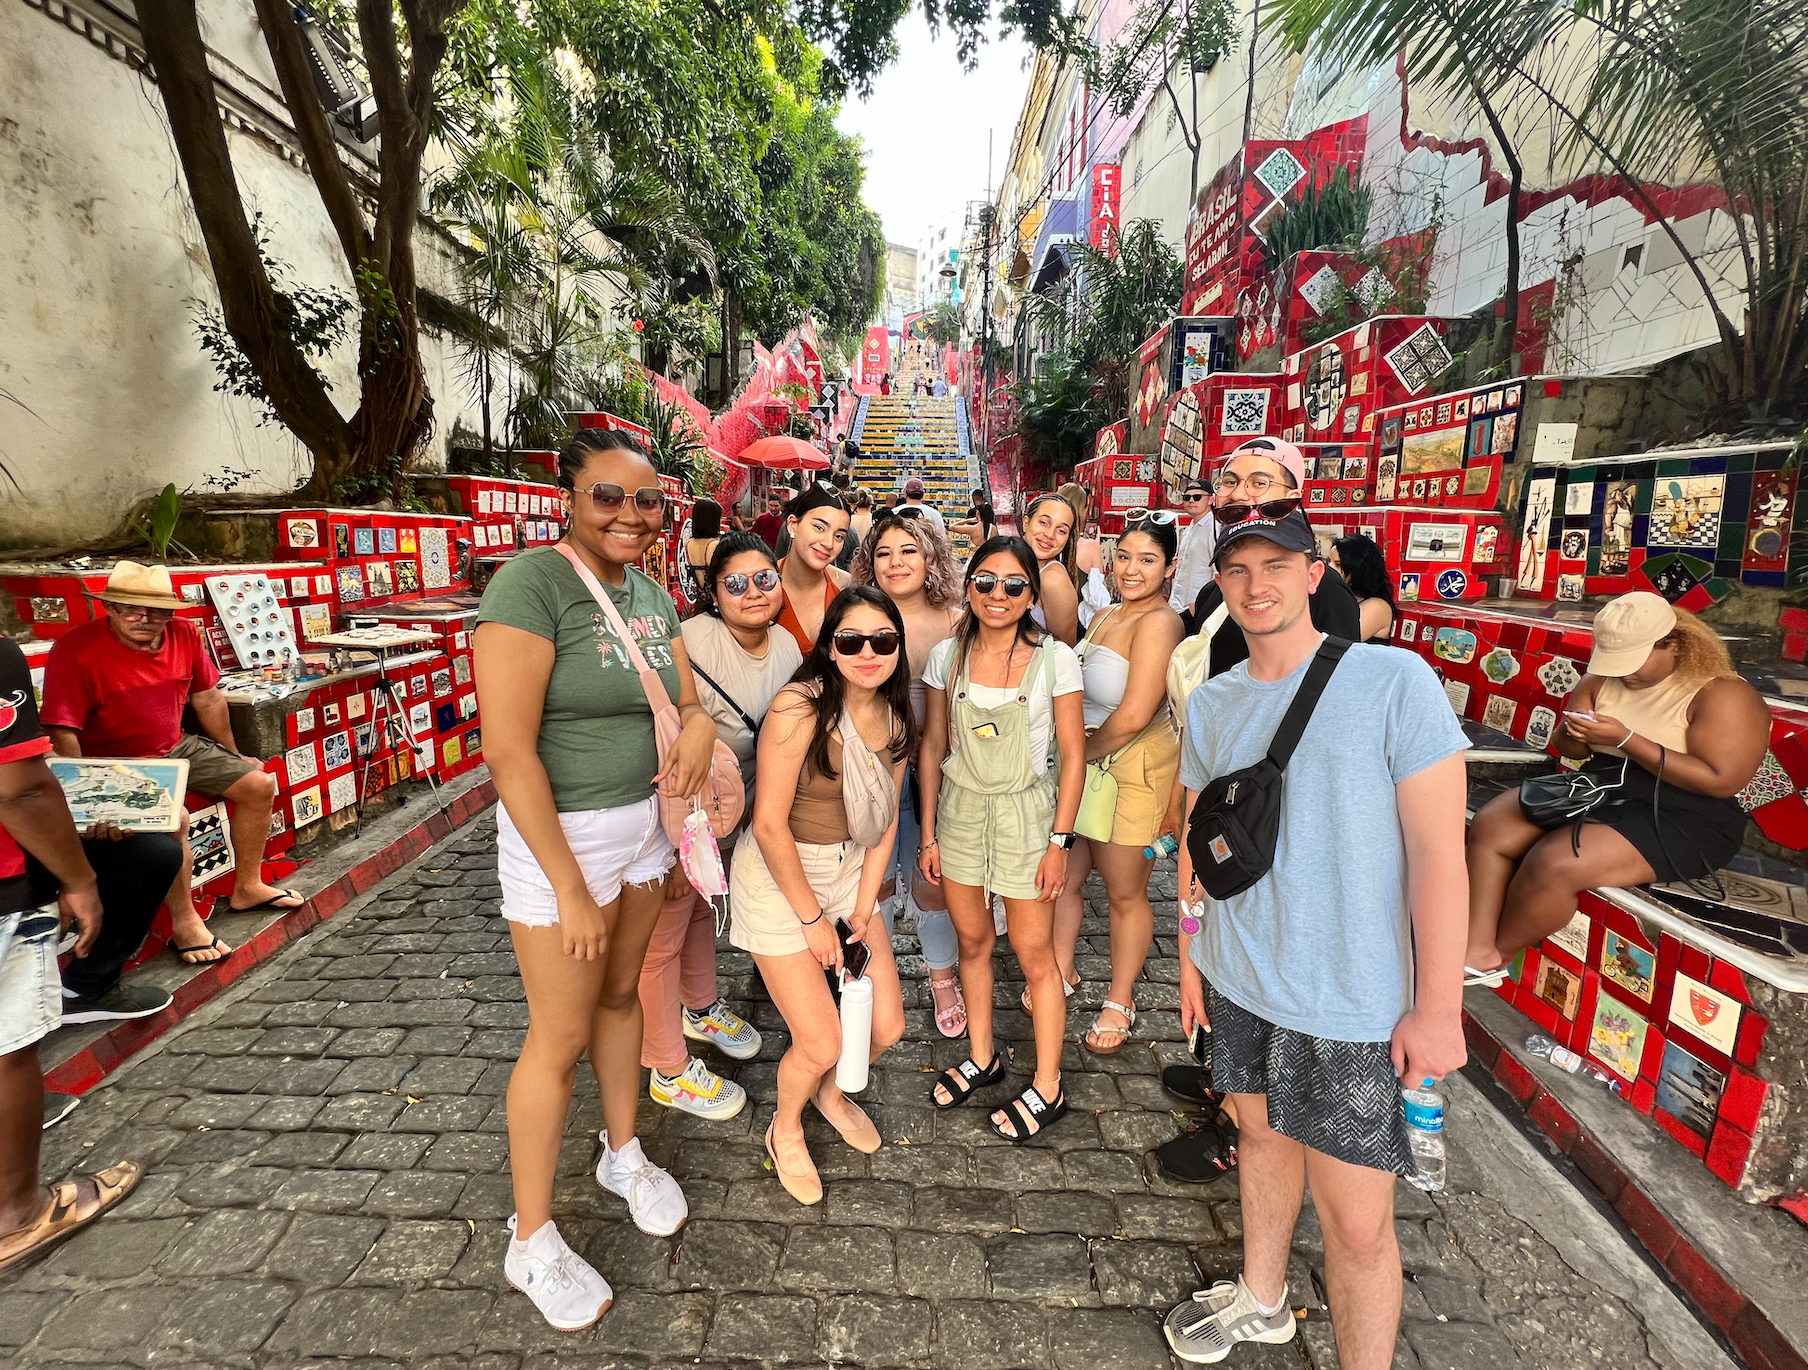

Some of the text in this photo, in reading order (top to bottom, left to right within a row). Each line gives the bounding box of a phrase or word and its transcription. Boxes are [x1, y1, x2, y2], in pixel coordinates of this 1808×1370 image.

[1189, 211, 1237, 267] EU TE AMO
[1228, 520, 1276, 535] EDUCATION
